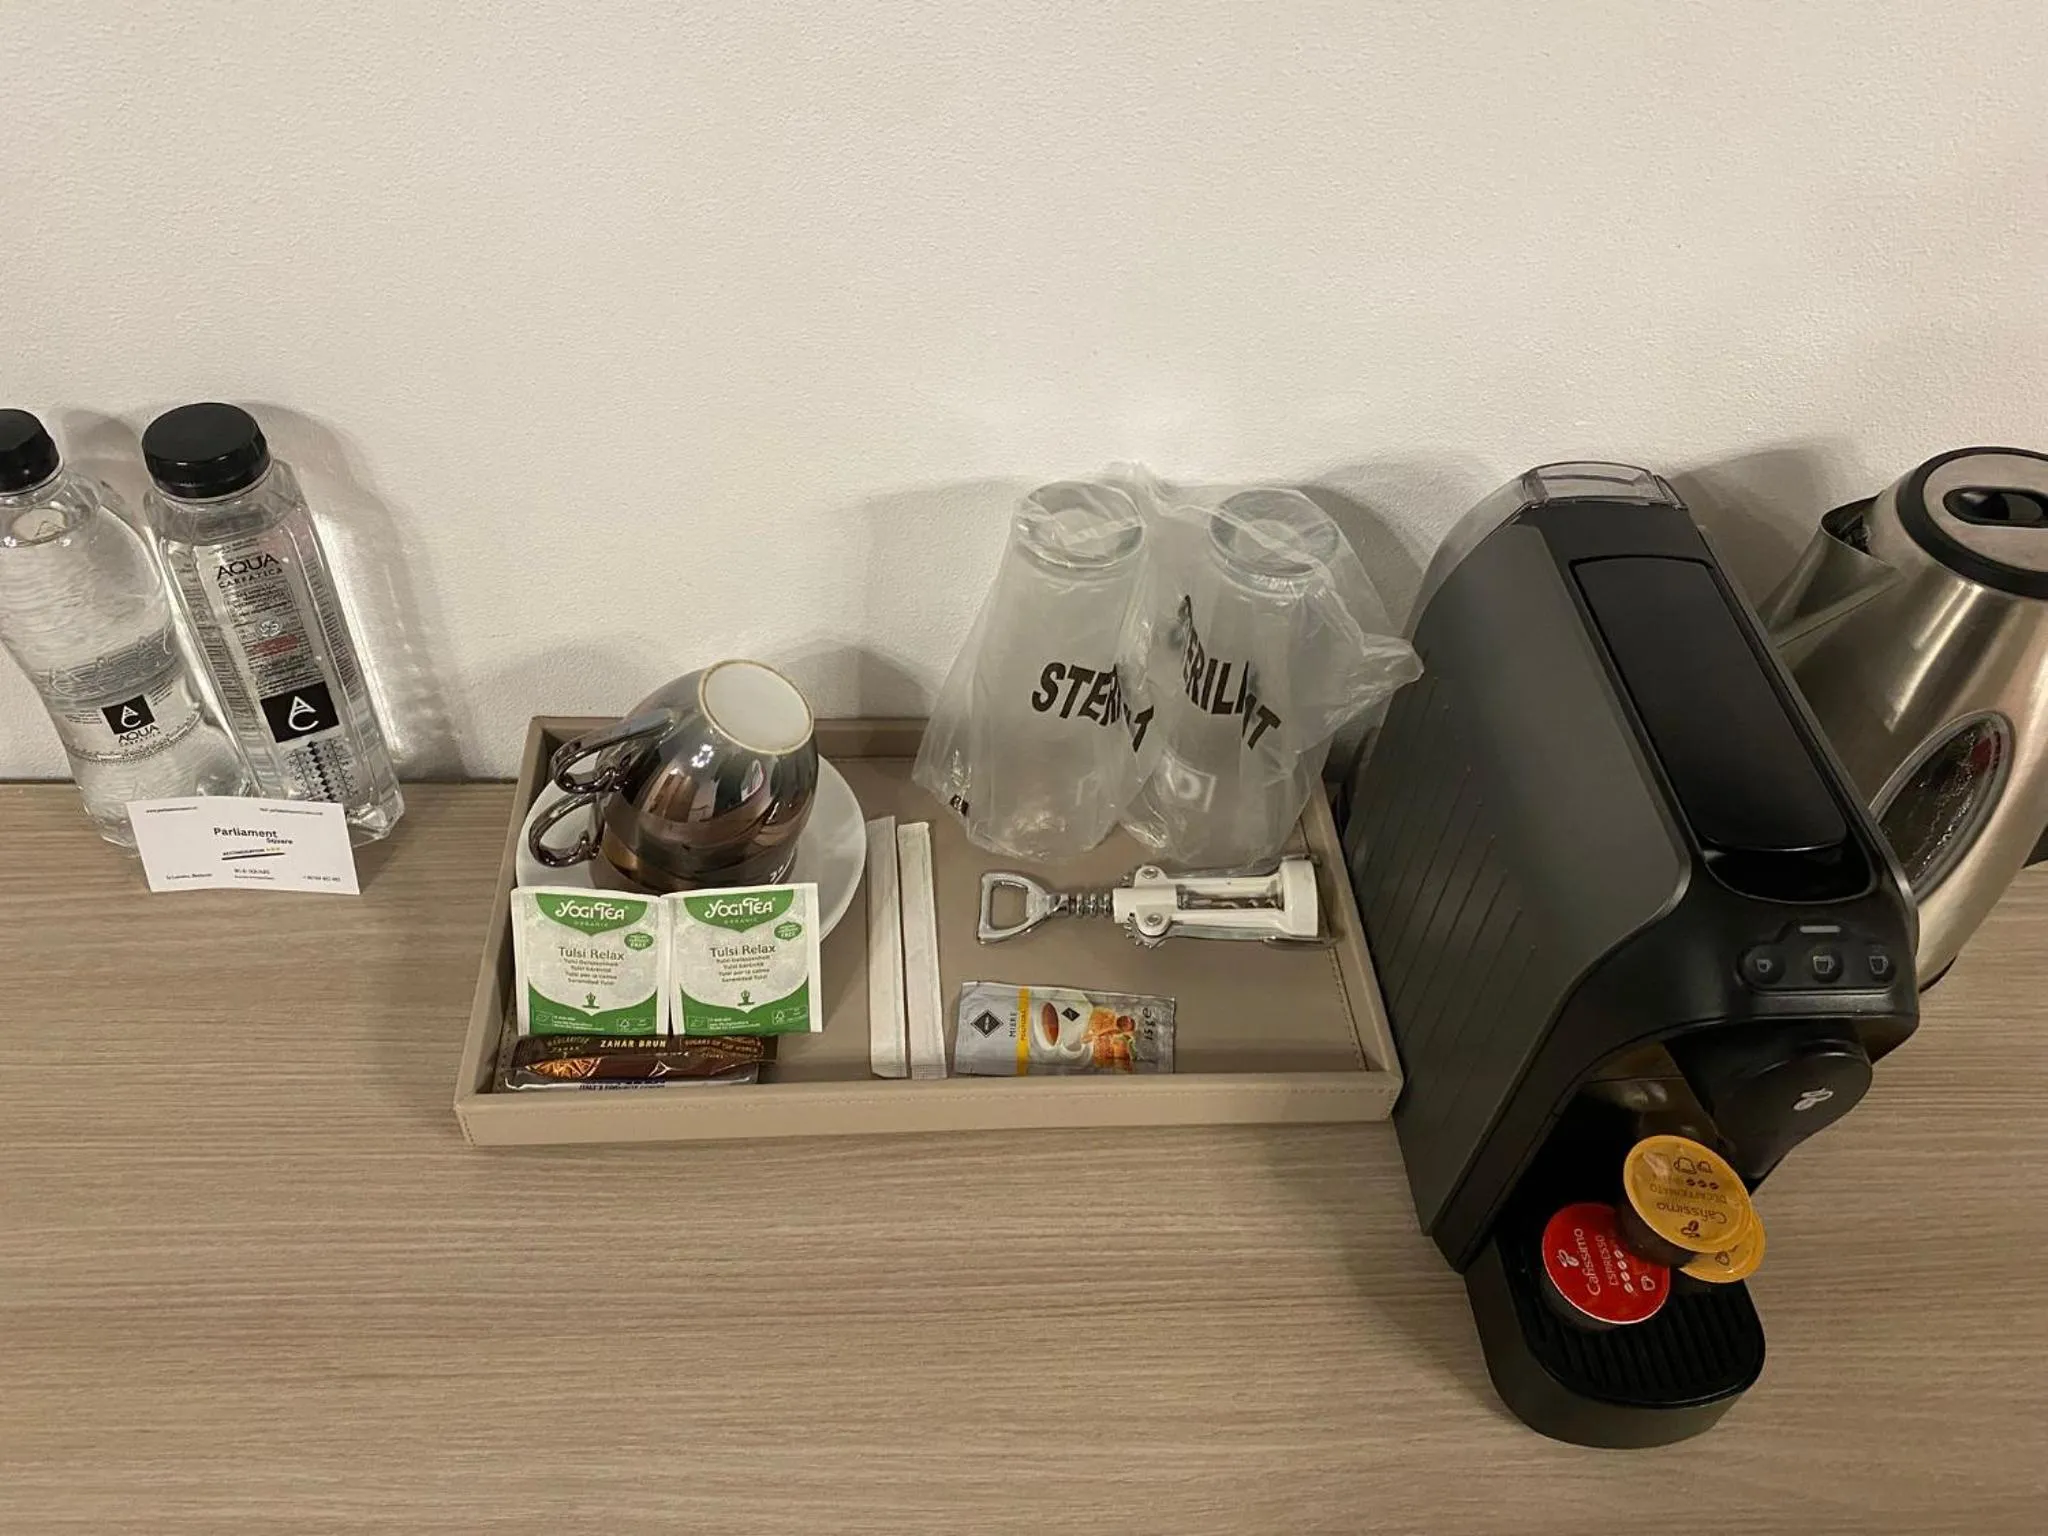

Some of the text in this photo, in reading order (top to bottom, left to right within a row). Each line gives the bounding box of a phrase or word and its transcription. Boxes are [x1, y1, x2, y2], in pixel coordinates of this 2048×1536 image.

[217, 553, 279, 580] AQUA
[118, 724, 160, 743] AQUA
[213, 827, 278, 838] Parliament
[266, 837, 293, 845] Square
[554, 900, 625, 920] YOGI TEA
[704, 897, 773, 919] YOGI TEA
[559, 946, 625, 961] Tulsi Relax
[709, 944, 776, 958] Tulsi Relax
[600, 1039, 635, 1048] ZAHAR
[638, 1039, 667, 1048] BRUN
[1656, 1202, 1728, 1224] Cafissimo
[1574, 1228, 1601, 1296] Cafissimo
[1594, 1234, 1620, 1286] ESPRESSO
